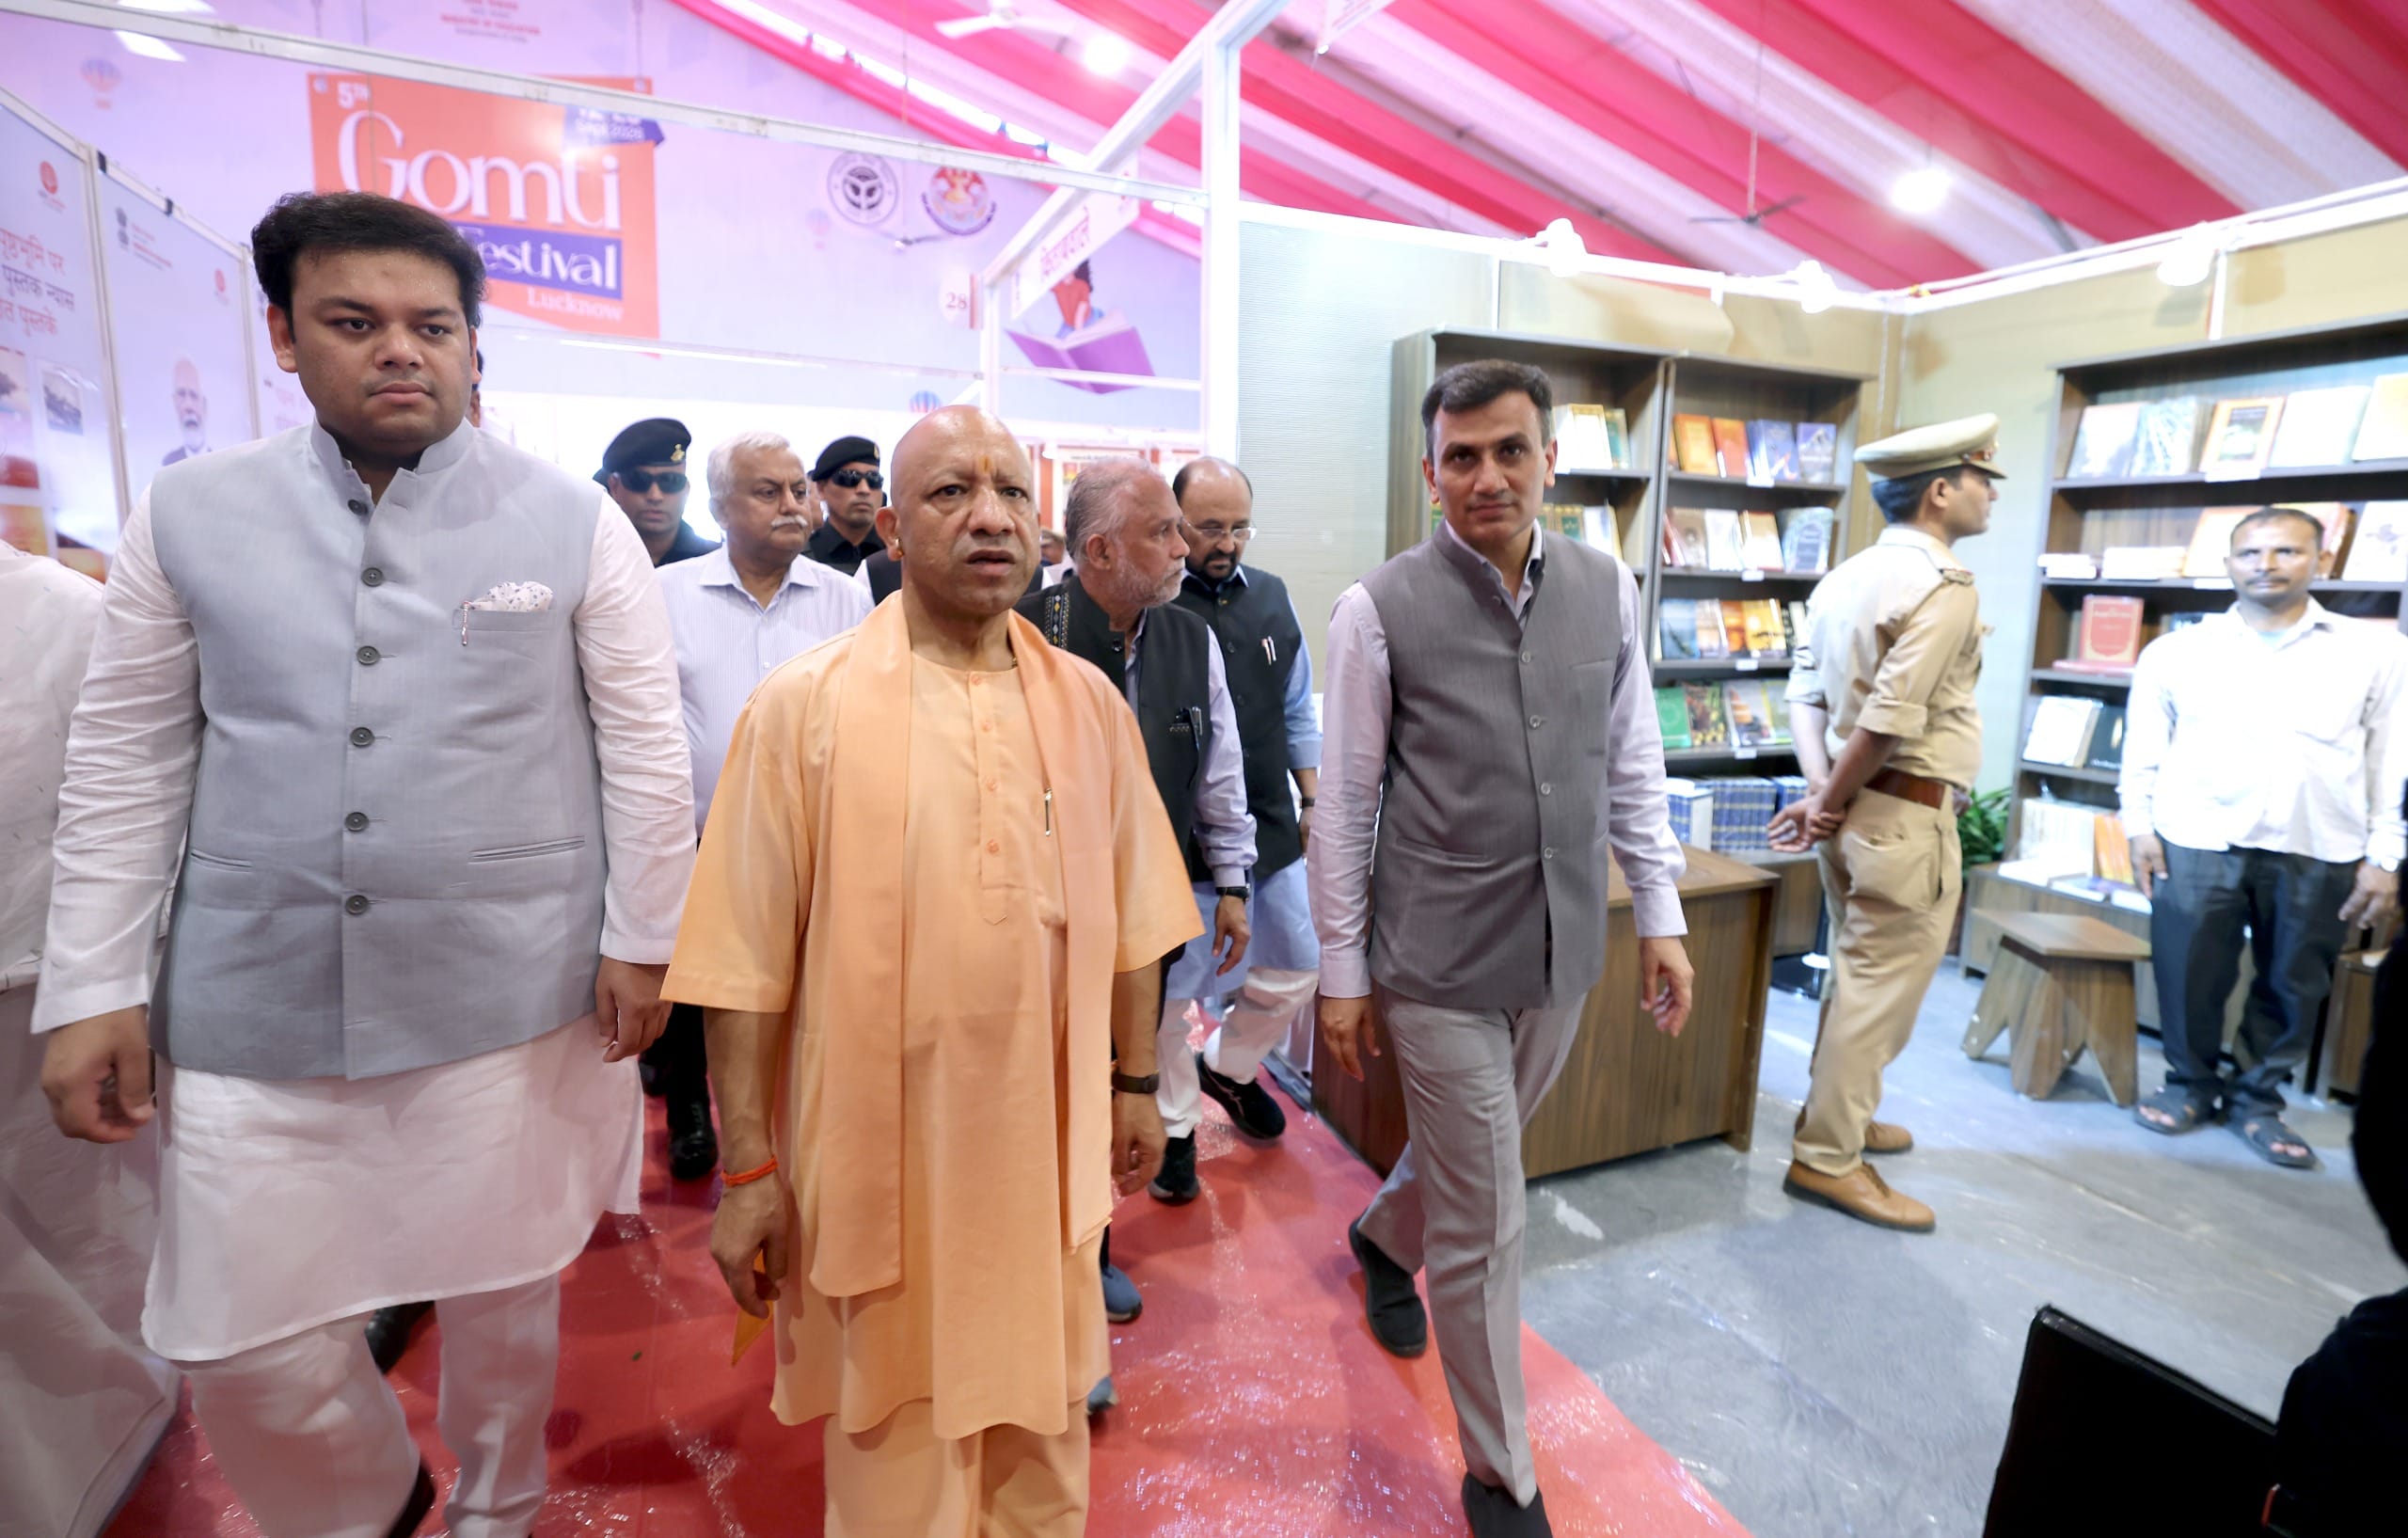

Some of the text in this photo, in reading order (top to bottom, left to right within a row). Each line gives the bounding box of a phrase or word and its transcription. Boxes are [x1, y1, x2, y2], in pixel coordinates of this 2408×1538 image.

[338, 109, 622, 231] Gomti
[527, 286, 624, 322] Lucknow
[945, 292, 967, 309] 28
